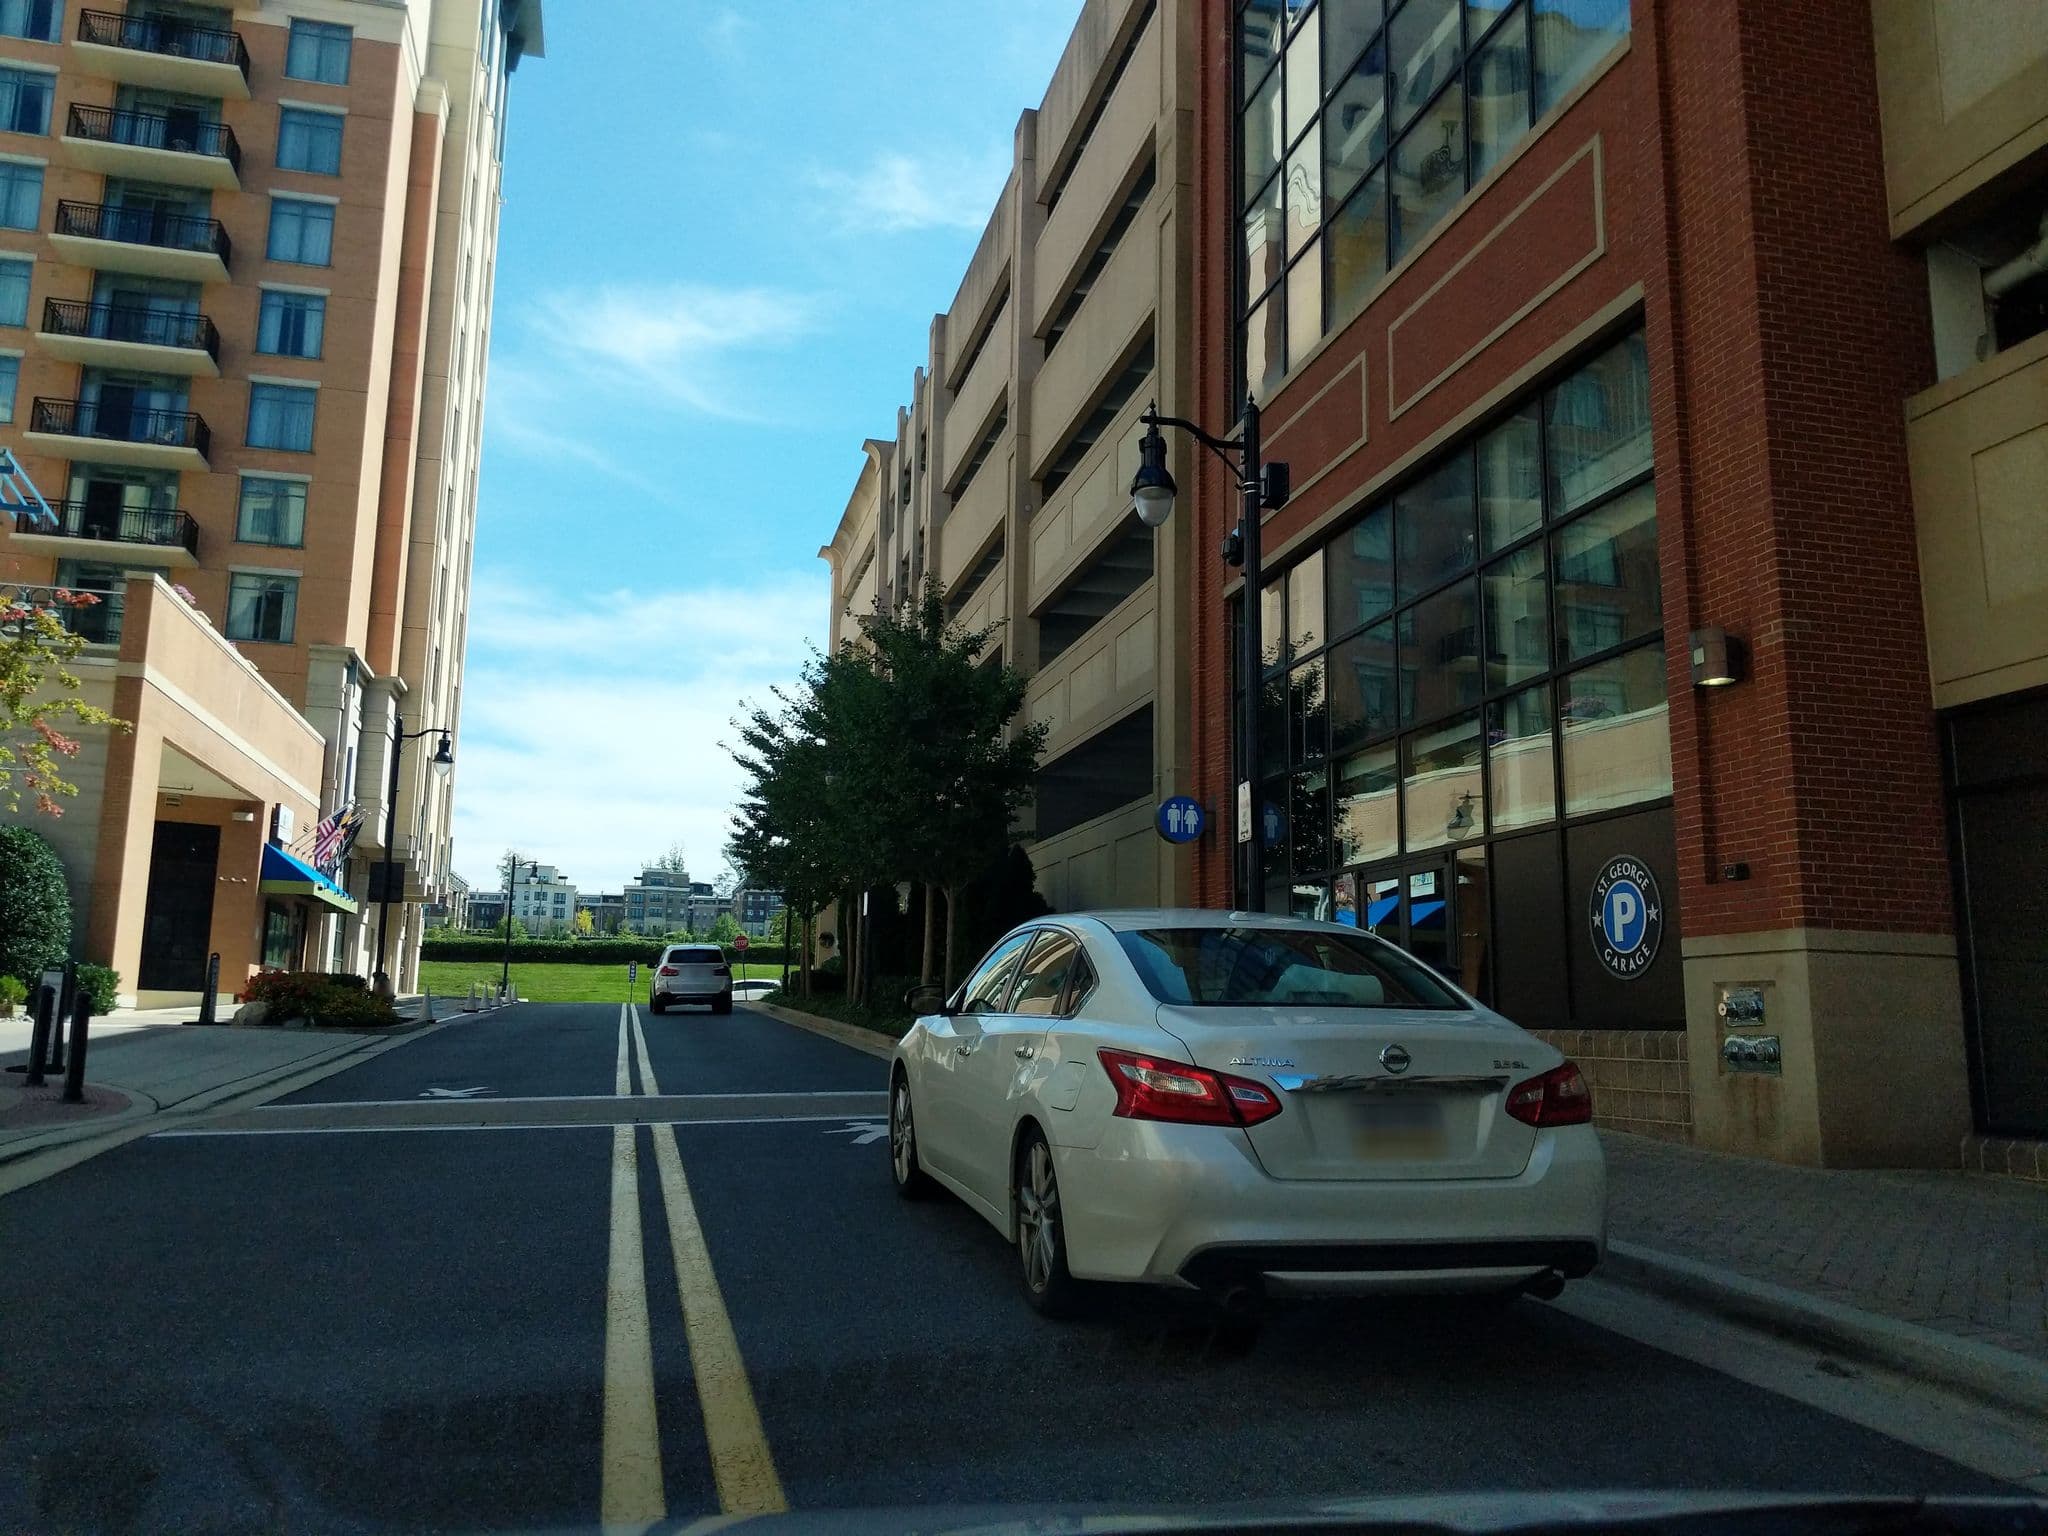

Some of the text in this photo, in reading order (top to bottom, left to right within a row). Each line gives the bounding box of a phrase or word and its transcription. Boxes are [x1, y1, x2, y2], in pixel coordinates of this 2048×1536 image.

[1609, 862, 1650, 890] GEORGE
[1612, 892, 1636, 942] P
[735, 939, 748, 947] STOP
[1604, 943, 1650, 972] GARAGE
[1229, 1057, 1295, 1067] ALTIMA
